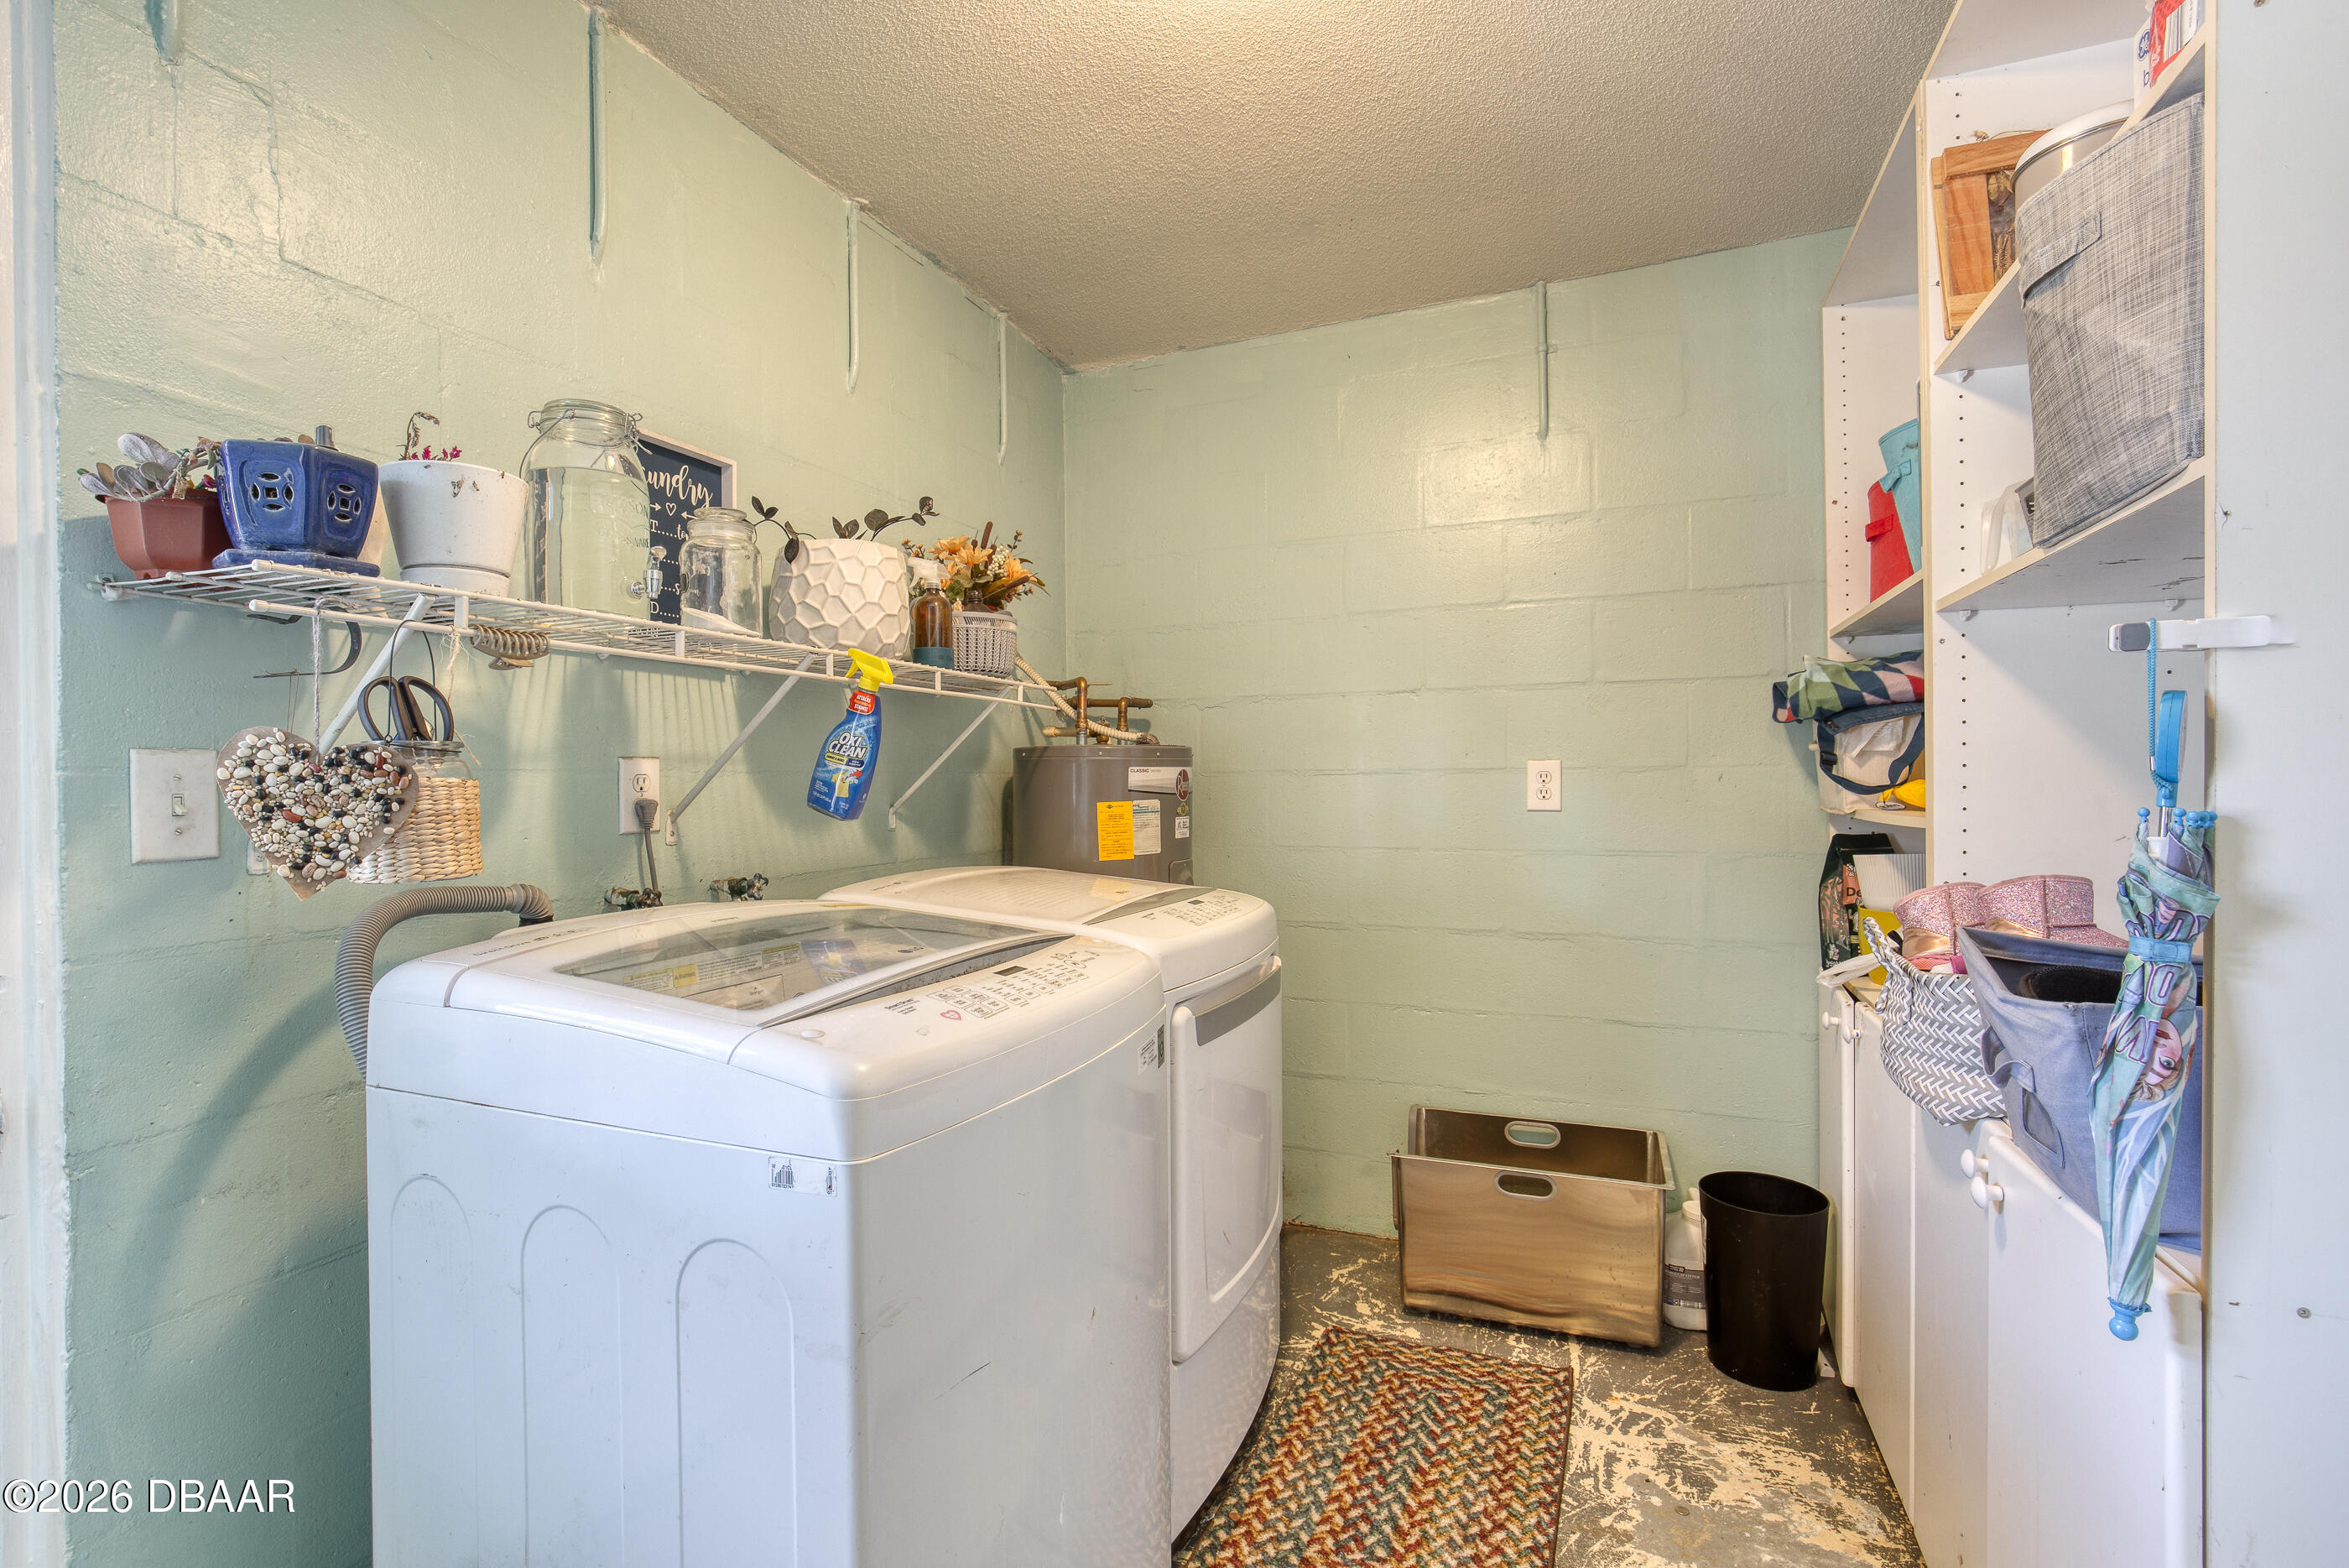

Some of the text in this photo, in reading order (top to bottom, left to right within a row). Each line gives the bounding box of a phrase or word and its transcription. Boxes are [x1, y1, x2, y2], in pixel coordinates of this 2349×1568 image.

[646, 465, 713, 508] undry
[839, 732, 864, 747] OXI
[828, 740, 867, 758] CLEAN
